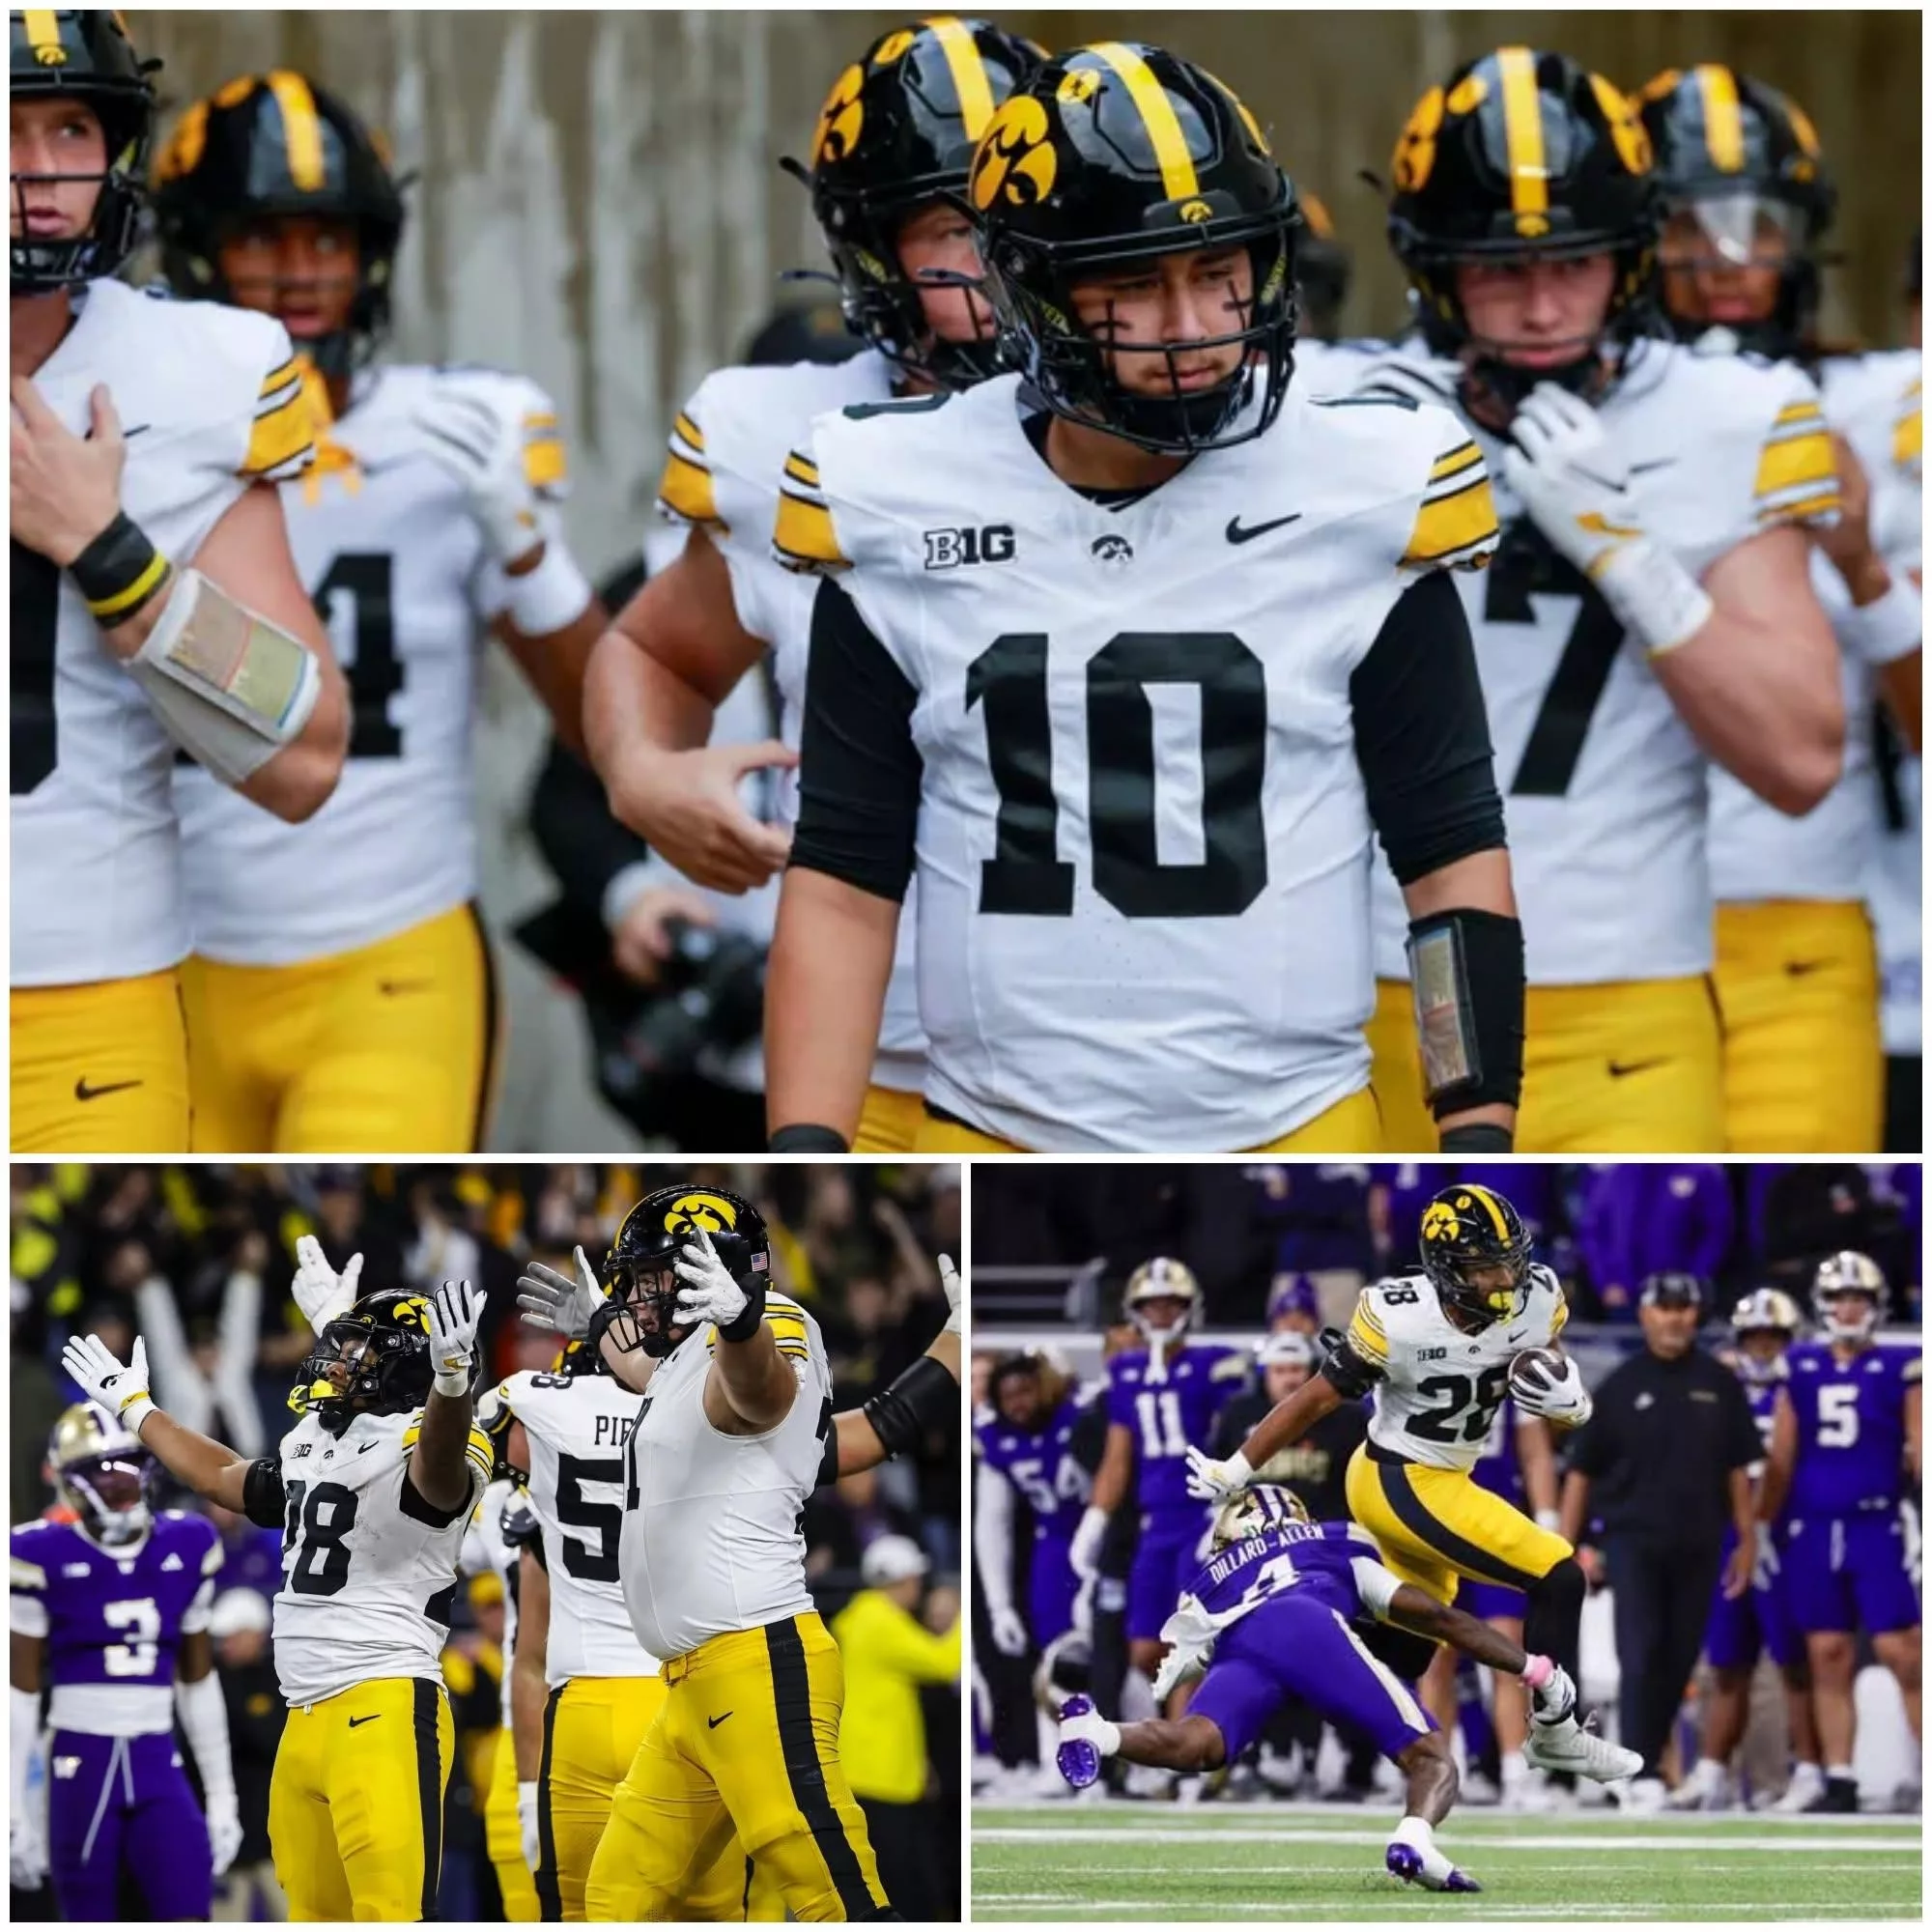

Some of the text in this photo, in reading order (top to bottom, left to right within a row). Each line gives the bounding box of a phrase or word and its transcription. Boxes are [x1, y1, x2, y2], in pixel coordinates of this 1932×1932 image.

[1484, 504, 1626, 797] 7
[965, 632, 1268, 918] 10
[1135, 1391, 1188, 1459] 11
[1405, 1366, 1509, 1442] 28
[1816, 1384, 1860, 1448] 5
[555, 1452, 624, 1582] 5
[1010, 1456, 1093, 1514] 54
[1208, 1523, 1325, 1584] DILLARD-ALLEN
[1241, 1552, 1301, 1605] 4
[103, 1597, 161, 1676] 3
